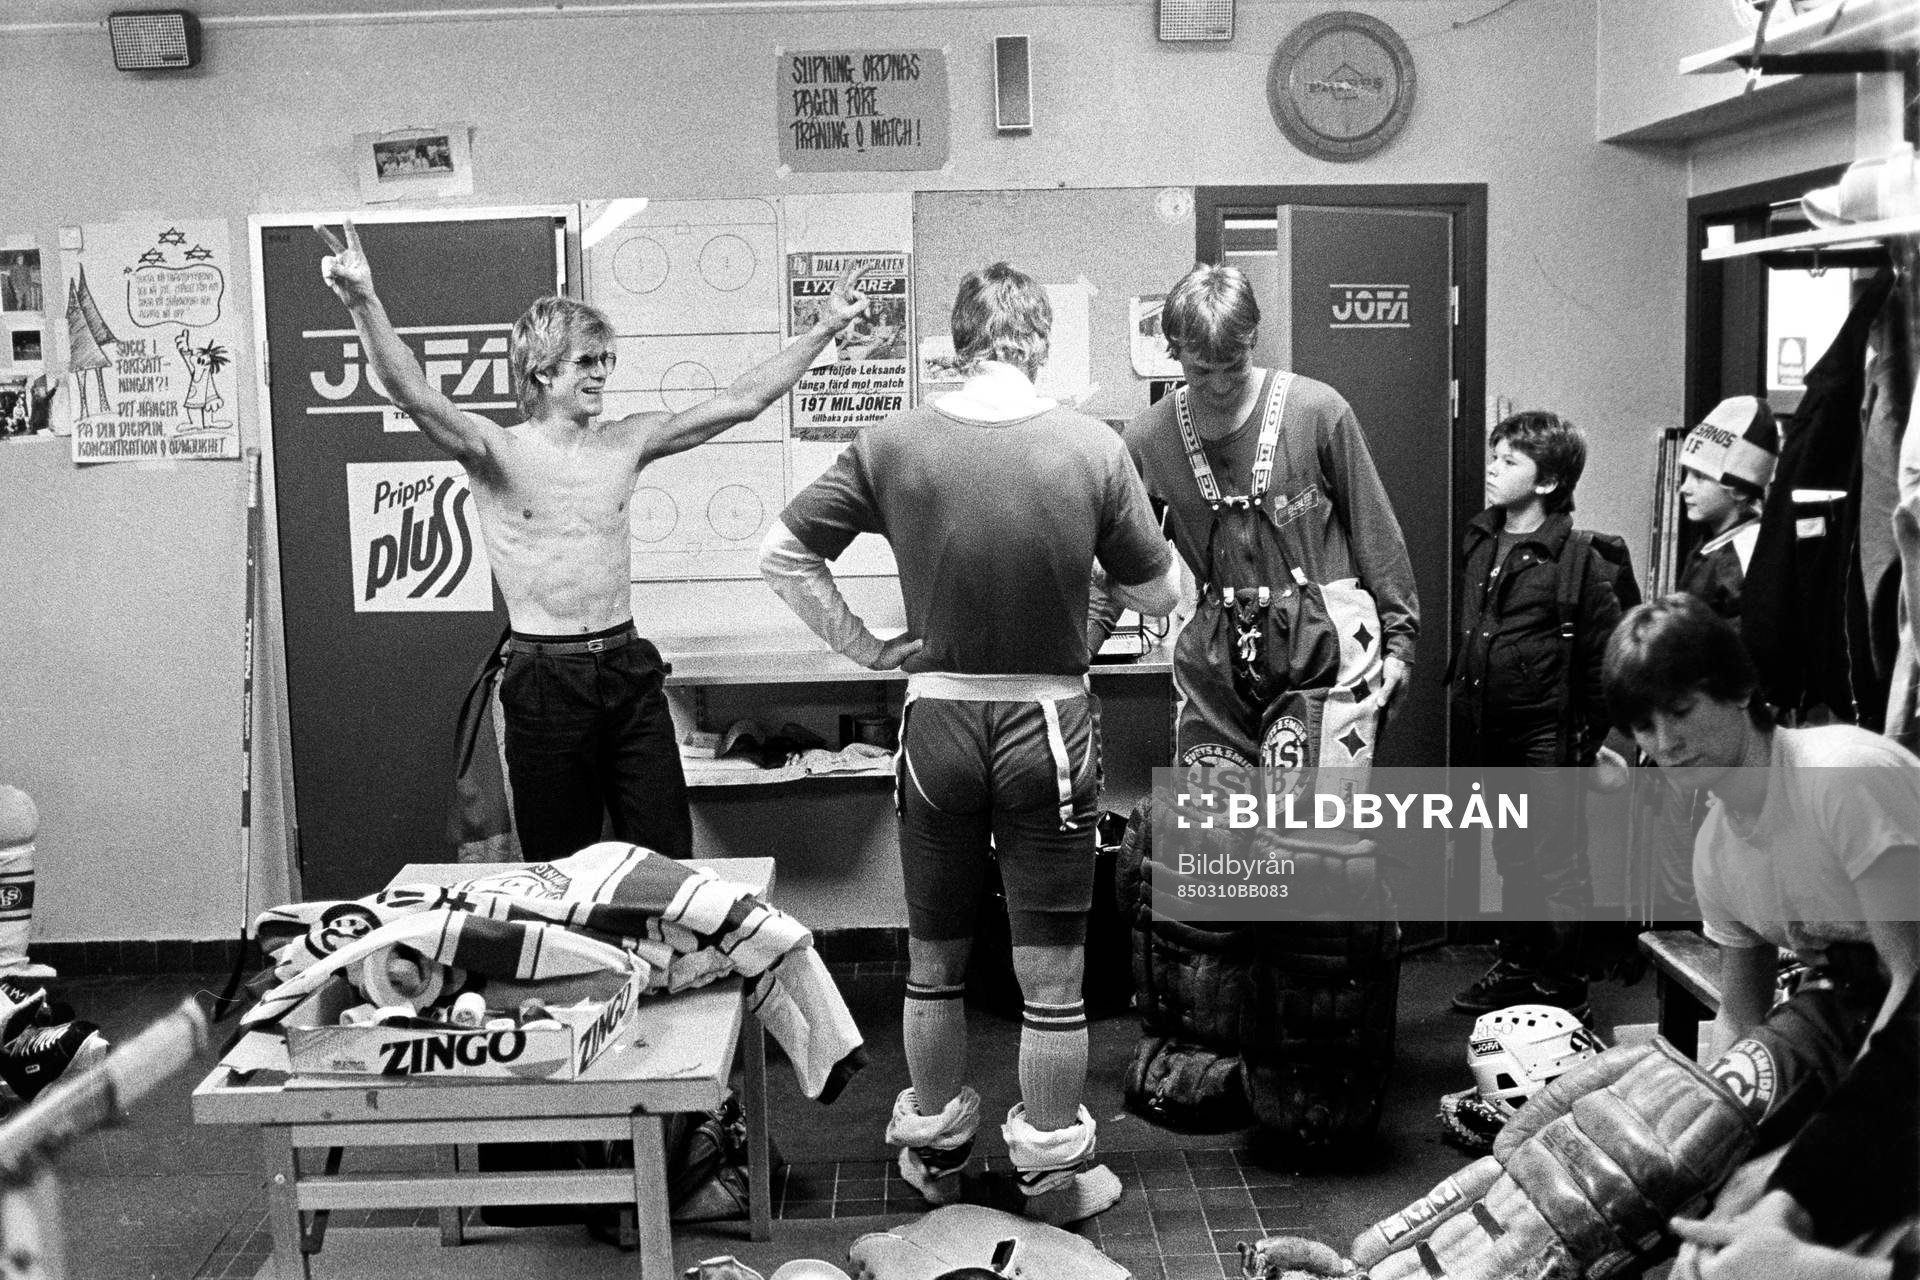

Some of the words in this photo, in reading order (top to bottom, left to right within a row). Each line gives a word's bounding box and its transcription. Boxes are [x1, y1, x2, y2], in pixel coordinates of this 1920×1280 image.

[862, 53, 921, 82] ORDNAS
[792, 88, 839, 117] DAGEN
[816, 258, 840, 272] DALA
[1332, 290, 1409, 321] JOFA
[310, 337, 510, 400] JFA
[829, 364, 857, 378] följde
[859, 364, 906, 376] Leksands
[799, 380, 826, 392] långa
[829, 379, 850, 389] färd
[852, 379, 872, 390] mot
[873, 378, 905, 389] match
[118, 400, 136, 417] DET
[801, 396, 828, 413] 197
[830, 395, 902, 411] MILJONER
[812, 414, 841, 422] tillbaka
[843, 414, 853, 424] på
[96, 422, 115, 438] DIN
[77, 438, 158, 457] KONCENTRATION
[374, 475, 435, 515] Pripps
[579, 983, 632, 1076] ZINGO
[378, 1031, 528, 1076] ZINGO
[1475, 1041, 1500, 1054] JOFA
